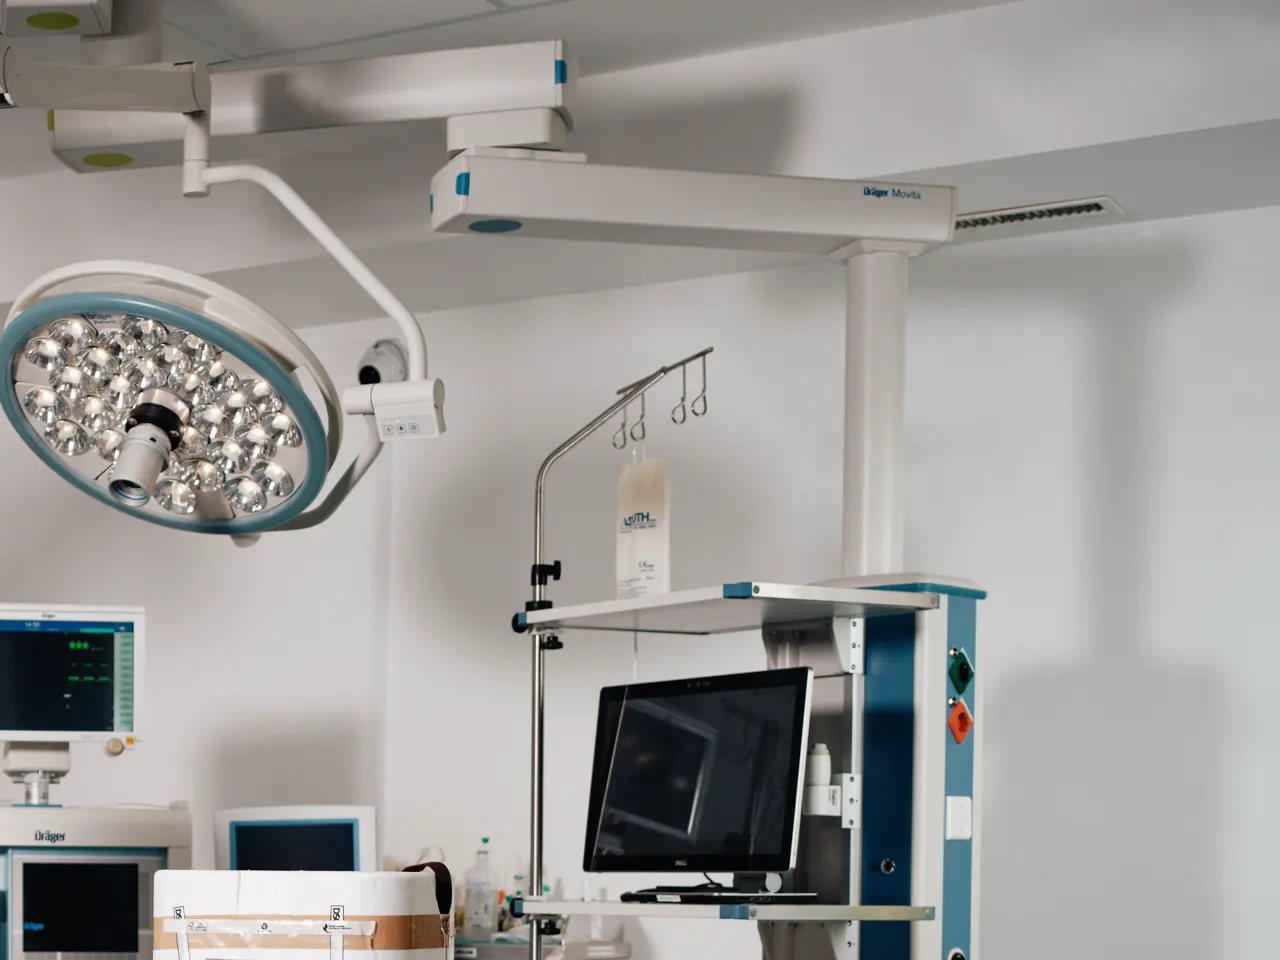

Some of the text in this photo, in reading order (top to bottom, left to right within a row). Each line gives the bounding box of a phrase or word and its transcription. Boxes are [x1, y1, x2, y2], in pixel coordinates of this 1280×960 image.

[863, 186, 921, 199] Dräger Movita
[35, 830, 66, 843] Dräger
